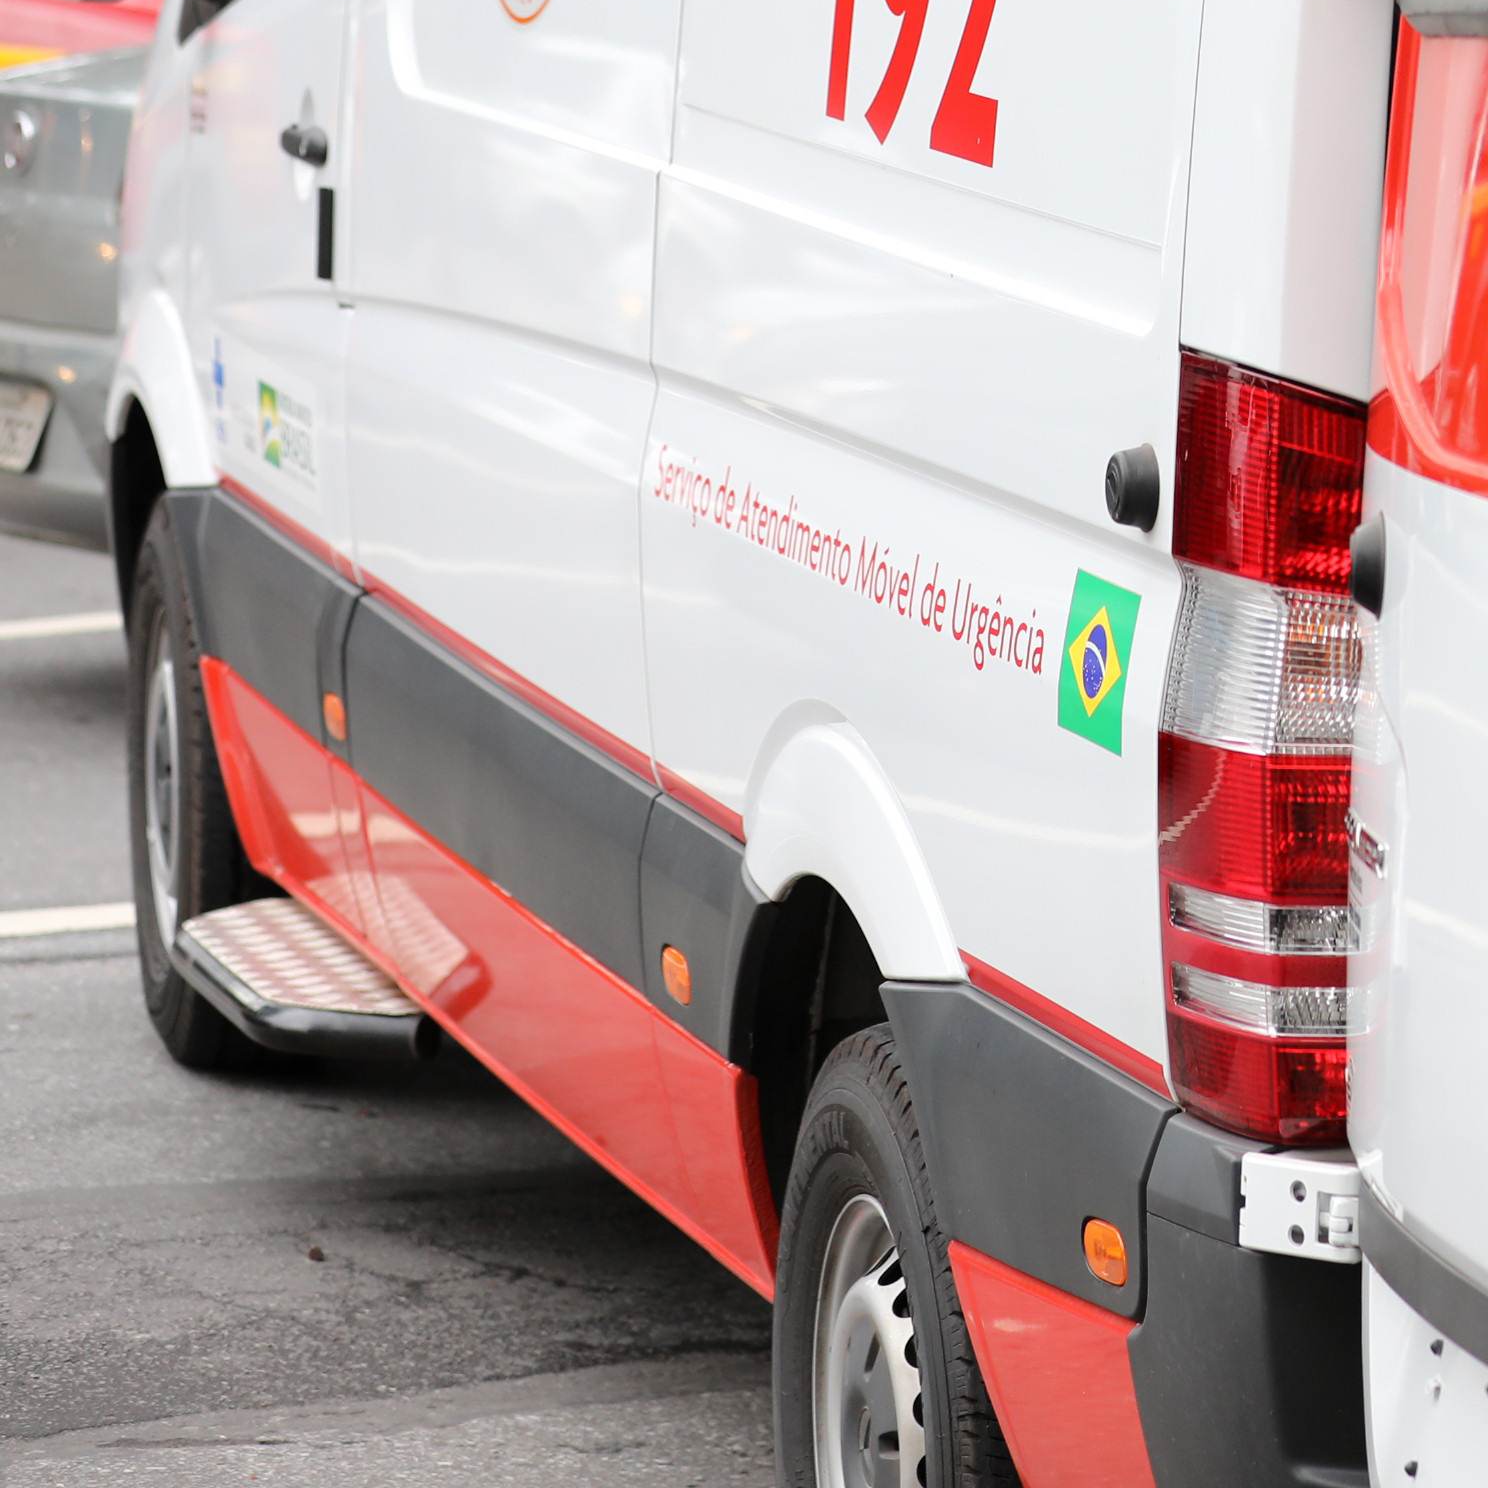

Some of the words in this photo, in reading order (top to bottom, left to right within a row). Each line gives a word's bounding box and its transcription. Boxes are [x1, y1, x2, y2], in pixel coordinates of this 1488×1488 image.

[654, 443, 712, 528] Serviço
[714, 465, 736, 529] de
[736, 481, 851, 586] Atendimento
[854, 535, 920, 619] Móvel
[920, 562, 947, 632] de
[951, 578, 1045, 675] Urgência
